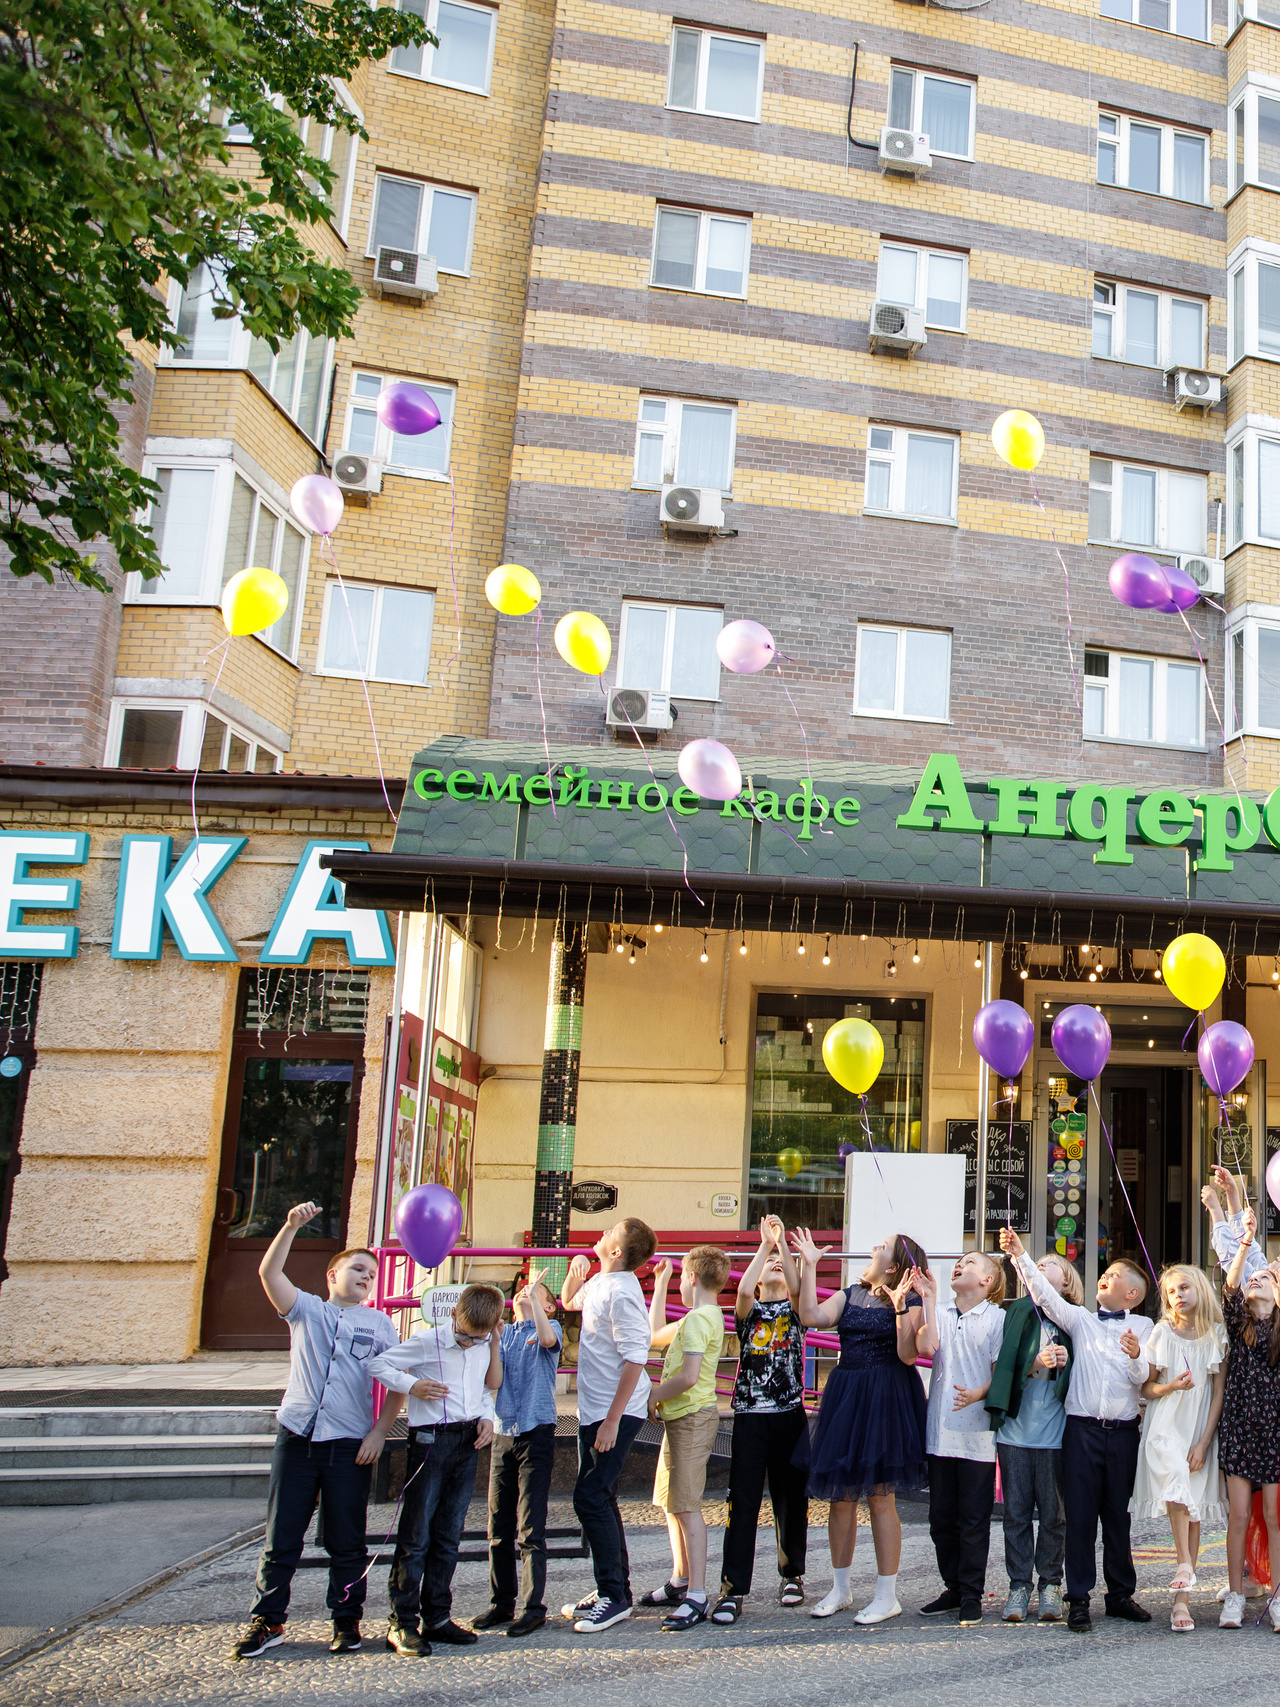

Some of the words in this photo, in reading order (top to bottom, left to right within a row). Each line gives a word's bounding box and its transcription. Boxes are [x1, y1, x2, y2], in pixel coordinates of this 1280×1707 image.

[413, 765, 701, 815] семейное
[719, 778, 861, 840] кафе
[1001, 1157, 1025, 1172] СОБОЙ
[432, 1291, 461, 1303] ПАРКОВ
[354, 1327, 375, 1336] UNIQUE
